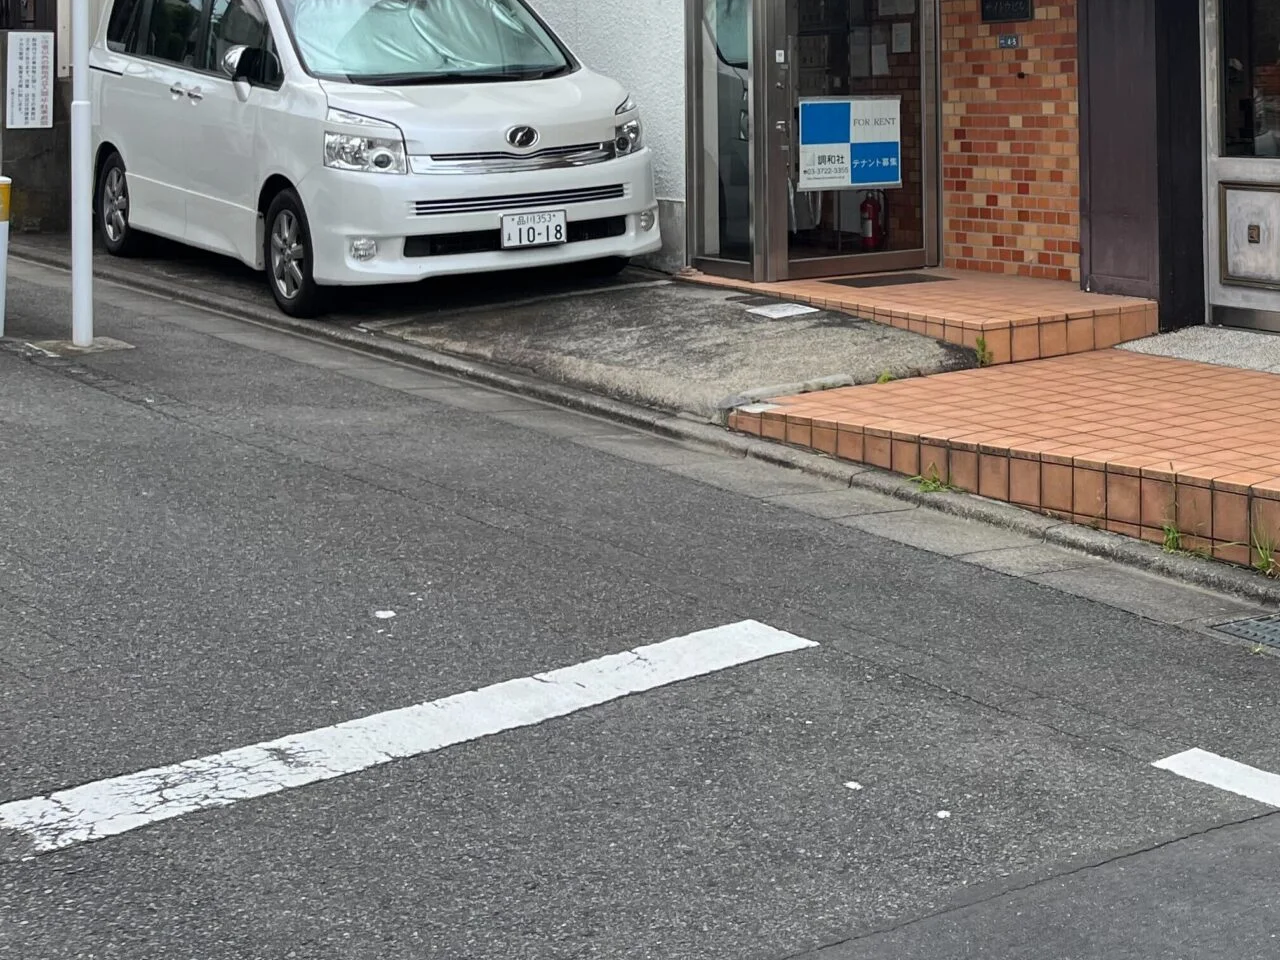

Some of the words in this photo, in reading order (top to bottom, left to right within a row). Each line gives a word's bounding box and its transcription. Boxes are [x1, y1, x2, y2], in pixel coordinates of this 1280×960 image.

[853, 118, 871, 127] FOR
[873, 117, 897, 126] RENT
[818, 154, 845, 166] 調和社
[852, 157, 897, 169] テナント募集
[518, 223, 563, 245] 10-18
